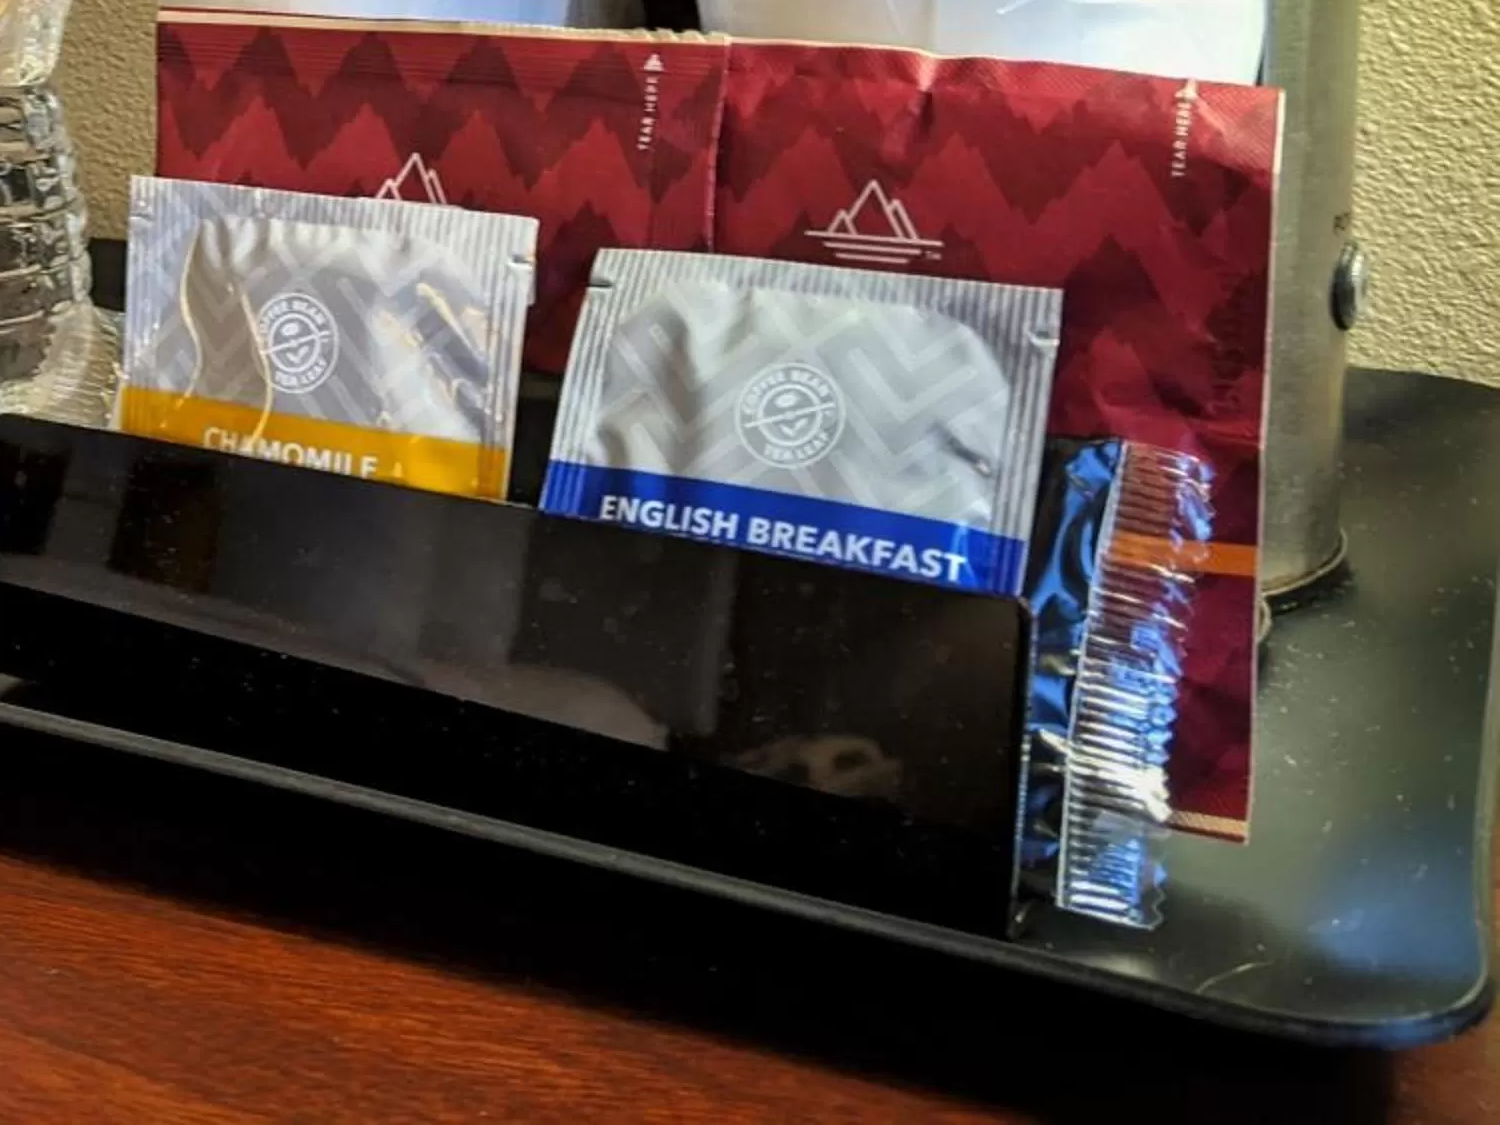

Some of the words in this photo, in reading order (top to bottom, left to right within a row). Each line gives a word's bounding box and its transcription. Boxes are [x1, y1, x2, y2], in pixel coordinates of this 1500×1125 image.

[203, 426, 379, 479] CHAMOMILE
[600, 494, 739, 541] ENGLISH
[746, 515, 968, 583] BREAKFAST
